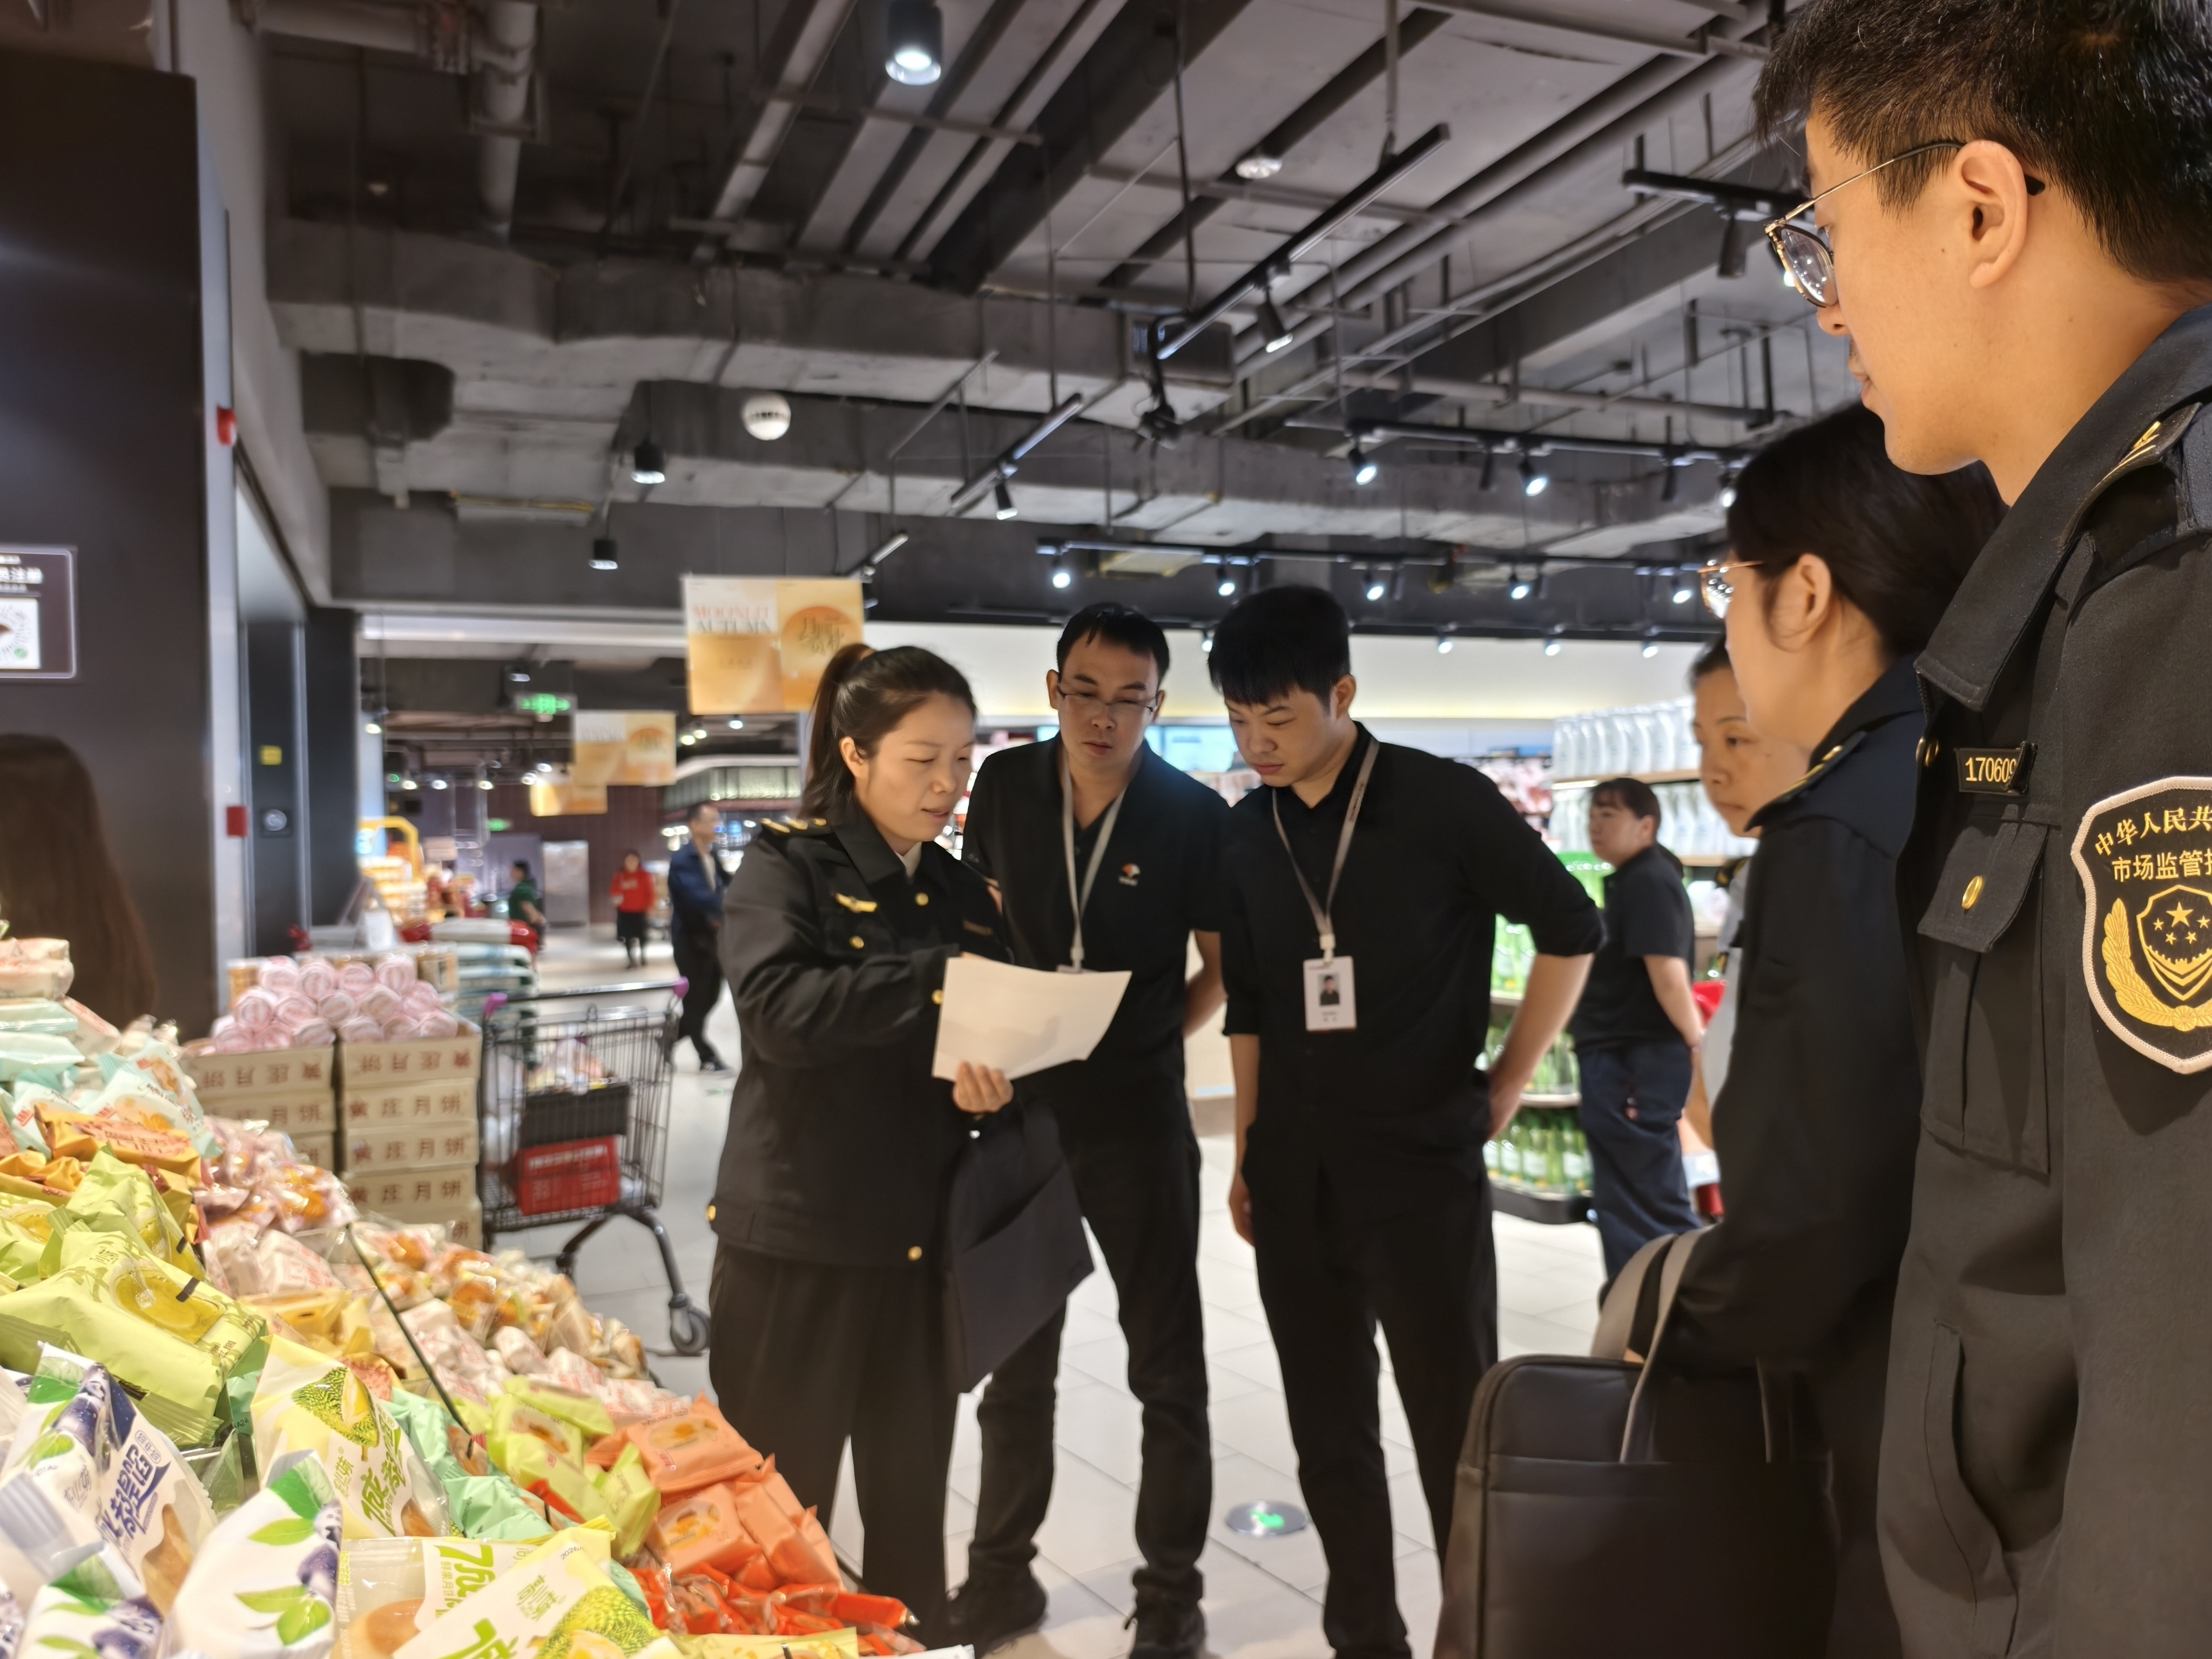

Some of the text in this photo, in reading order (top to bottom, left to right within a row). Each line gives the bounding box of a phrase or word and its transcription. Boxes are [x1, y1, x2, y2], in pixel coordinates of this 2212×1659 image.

[2095, 805, 2212, 855] 中华人民共
